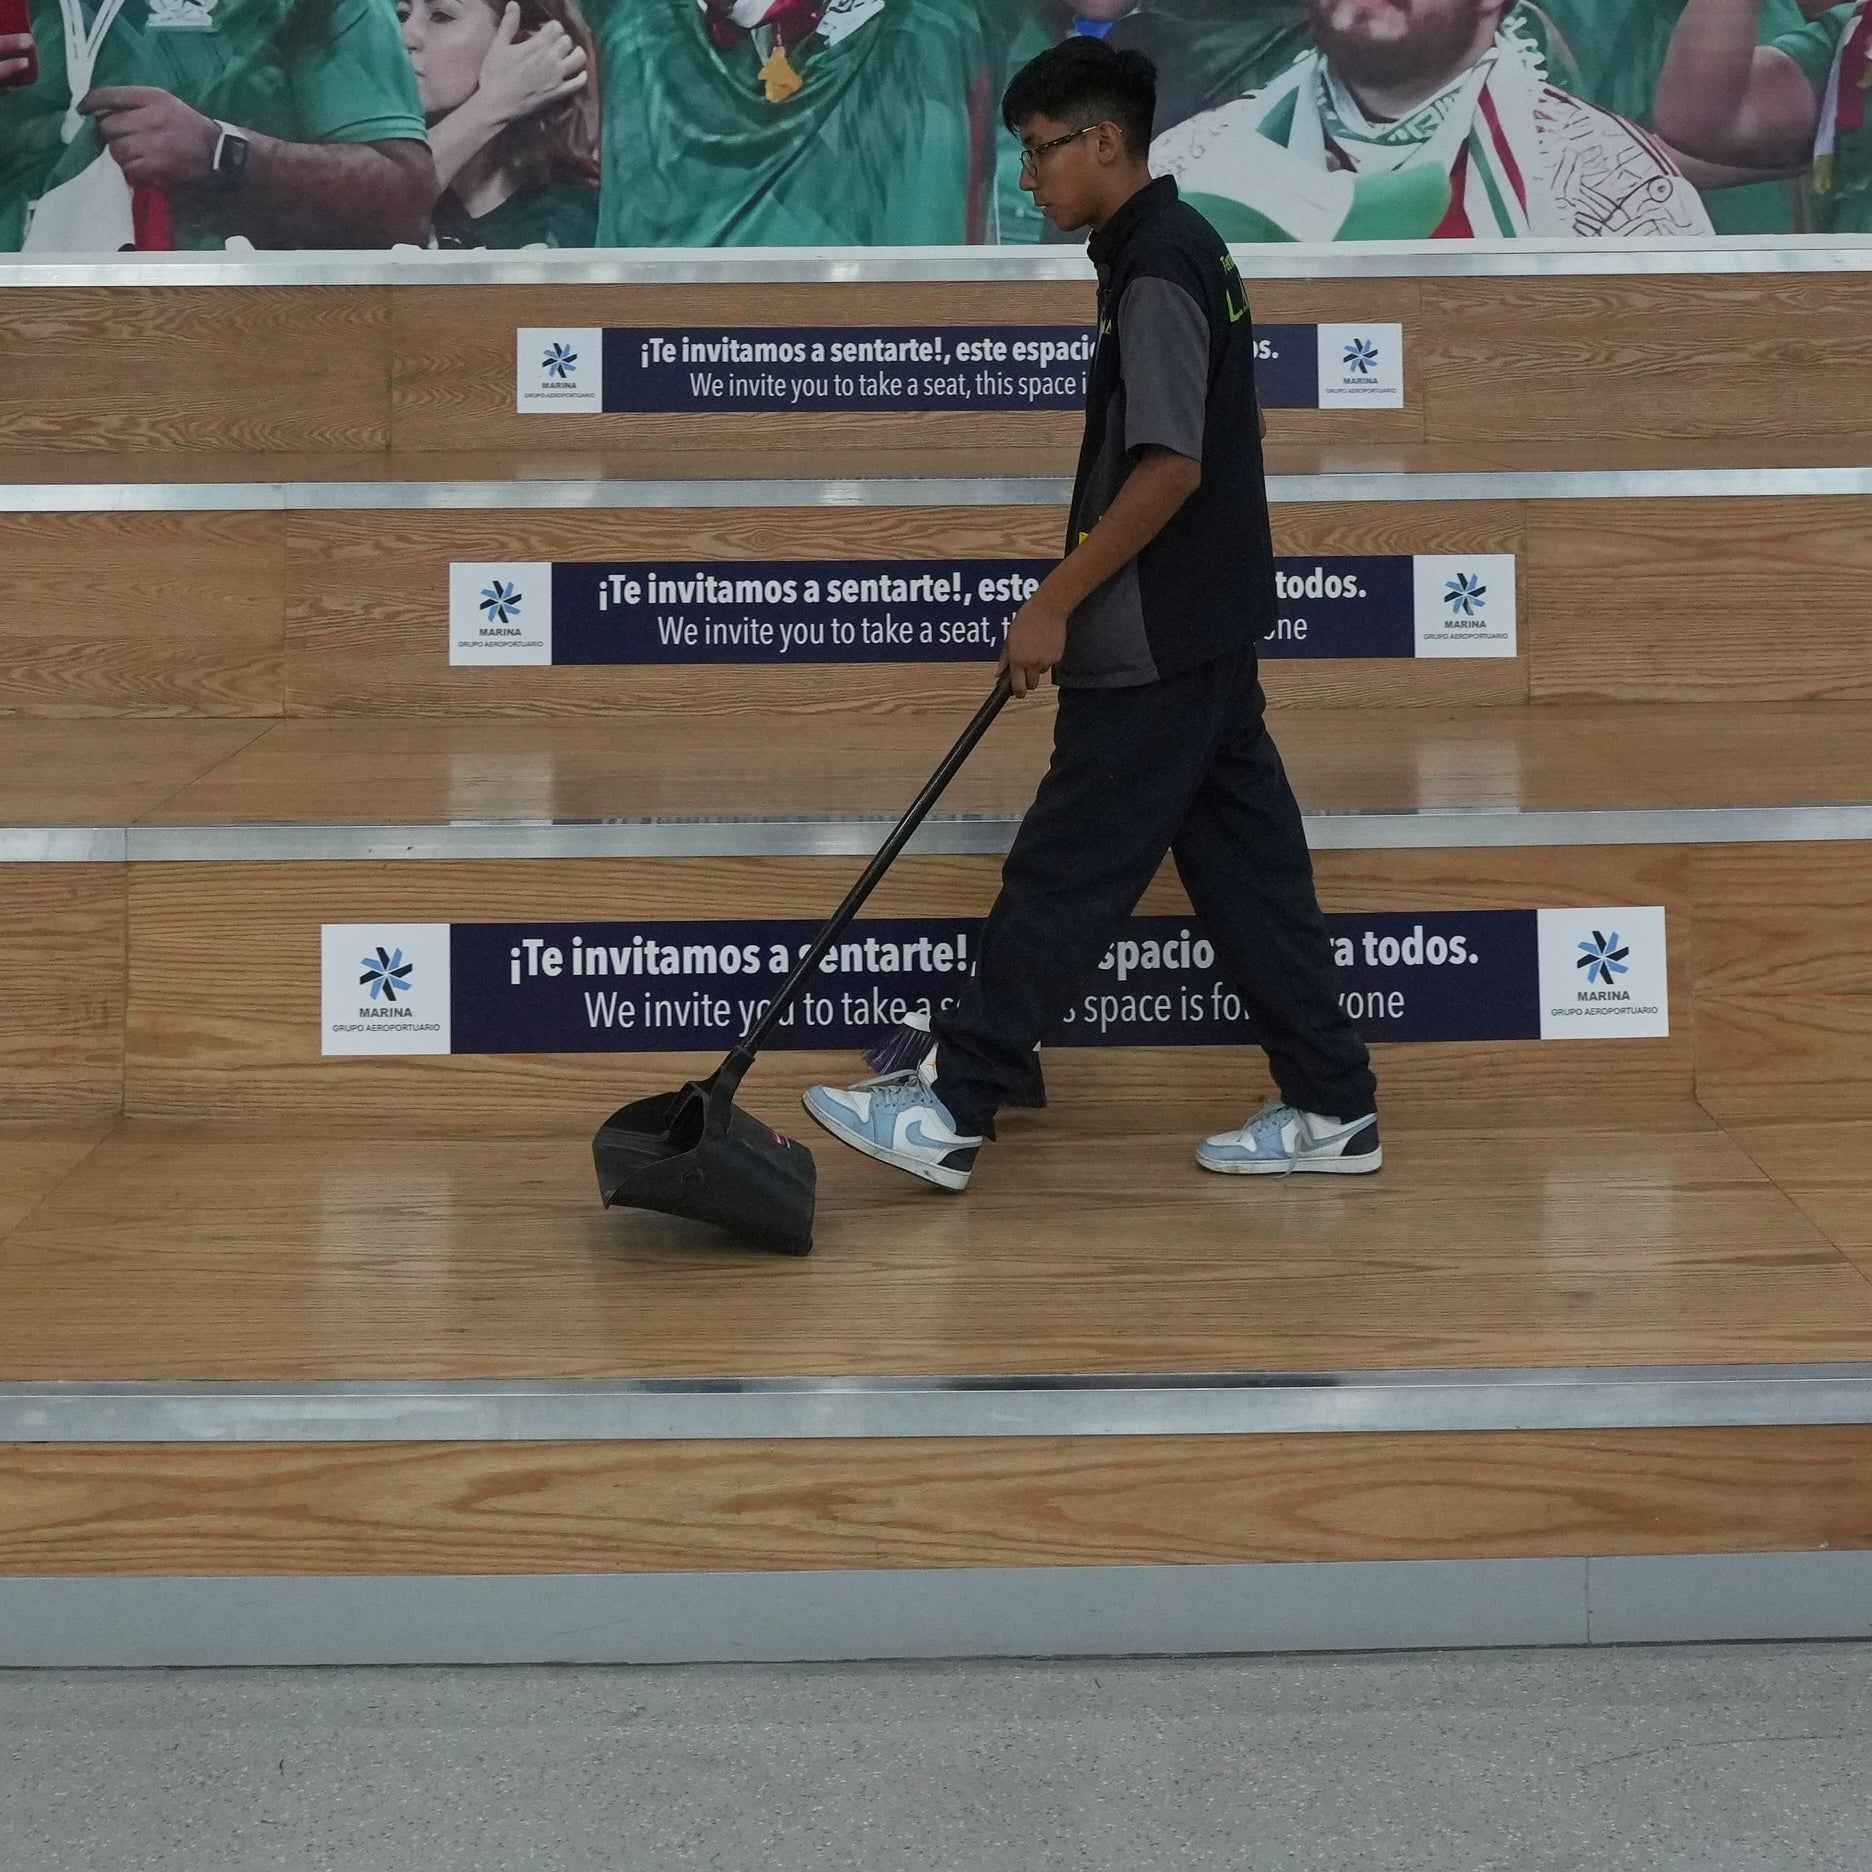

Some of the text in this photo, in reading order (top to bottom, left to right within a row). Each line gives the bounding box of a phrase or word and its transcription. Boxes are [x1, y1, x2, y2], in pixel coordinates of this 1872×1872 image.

[641, 337, 677, 368] ¡Te
[681, 336, 807, 363] invitamos
[810, 342, 825, 363] a
[829, 336, 952, 365] sentarte!,
[955, 338, 1008, 362] este
[689, 372, 724, 397] We
[729, 372, 787, 397] invite
[790, 378, 828, 404] you
[832, 374, 854, 397] to
[858, 370, 903, 396] take
[907, 377, 918, 396] a
[923, 373, 971, 399] seat,
[974, 369, 1014, 396] this
[1018, 376, 1077, 403] space
[1343, 377, 1379, 385] MARINA
[599, 566, 1367, 611] ¡Te invitamos a sentarte!, este todos.
[1444, 620, 1487, 629] MARINA
[478, 628, 522, 637] MARINA
[657, 616, 698, 646] We
[705, 616, 774, 645] invite
[779, 622, 824, 654] you
[830, 618, 856, 644] to
[860, 612, 914, 644] take
[919, 621, 933, 644] a
[939, 616, 997, 648] seat,
[510, 938, 564, 985] ¡Te
[572, 935, 761, 976] invitamos
[768, 944, 789, 974] a
[1097, 929, 1215, 981] spacio
[1361, 925, 1479, 967] todos.
[1577, 990, 1631, 1002] MARINA
[359, 1007, 413, 1018] MARINA
[584, 991, 636, 1028] We
[644, 991, 731, 1027] invite
[802, 992, 834, 1026] to
[839, 984, 908, 1027] take
[1084, 994, 1171, 1034] space
[1181, 985, 1204, 1022] is
[1550, 1006, 1659, 1017] GRUPO AEROPORTUARIO
[332, 1023, 441, 1033] GRUPO AEROPORTUARIO
